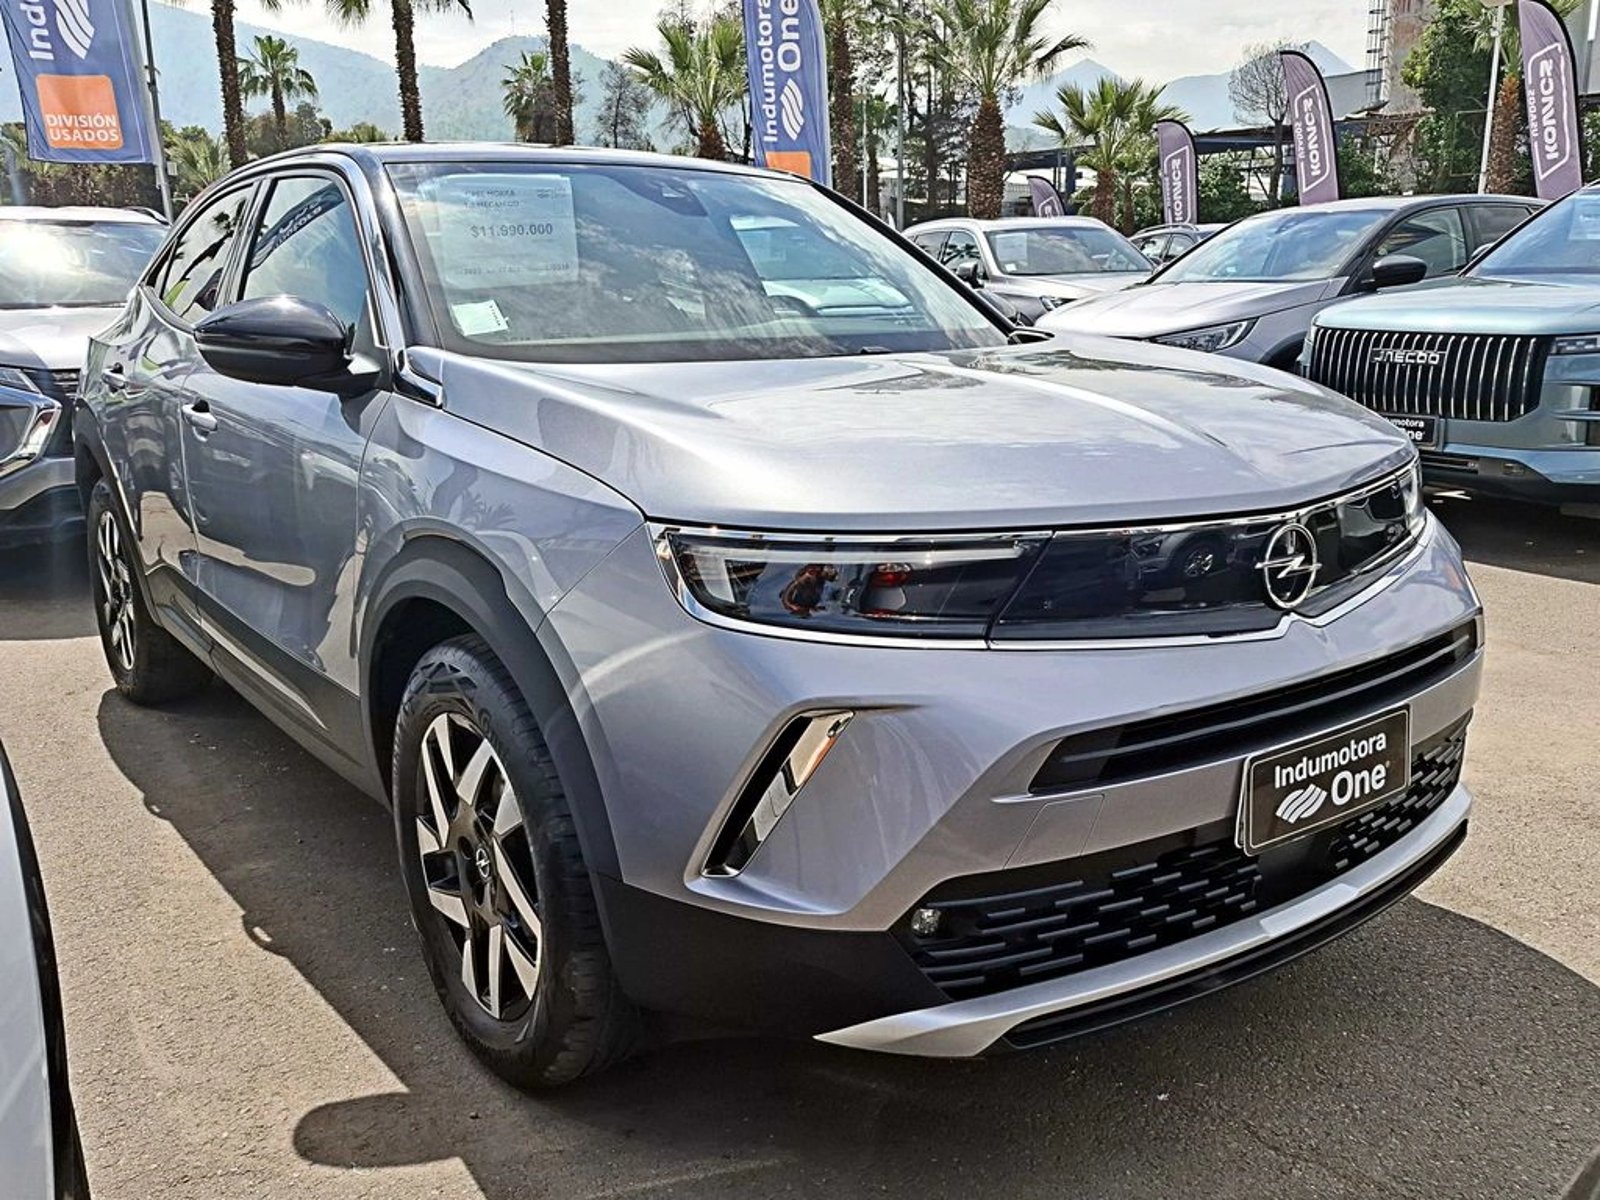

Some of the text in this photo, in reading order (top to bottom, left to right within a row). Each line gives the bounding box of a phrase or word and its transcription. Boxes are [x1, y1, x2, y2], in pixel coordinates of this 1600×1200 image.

[20, 0, 54, 60] Ind
[777, 0, 802, 72] One
[45, 112, 117, 128] DIVISIÓN
[49, 129, 120, 142] USADOS
[1386, 418, 1425, 428] motora
[1407, 430, 1423, 440] ne
[1274, 732, 1387, 789] Indumotora
[1330, 763, 1387, 806] One
